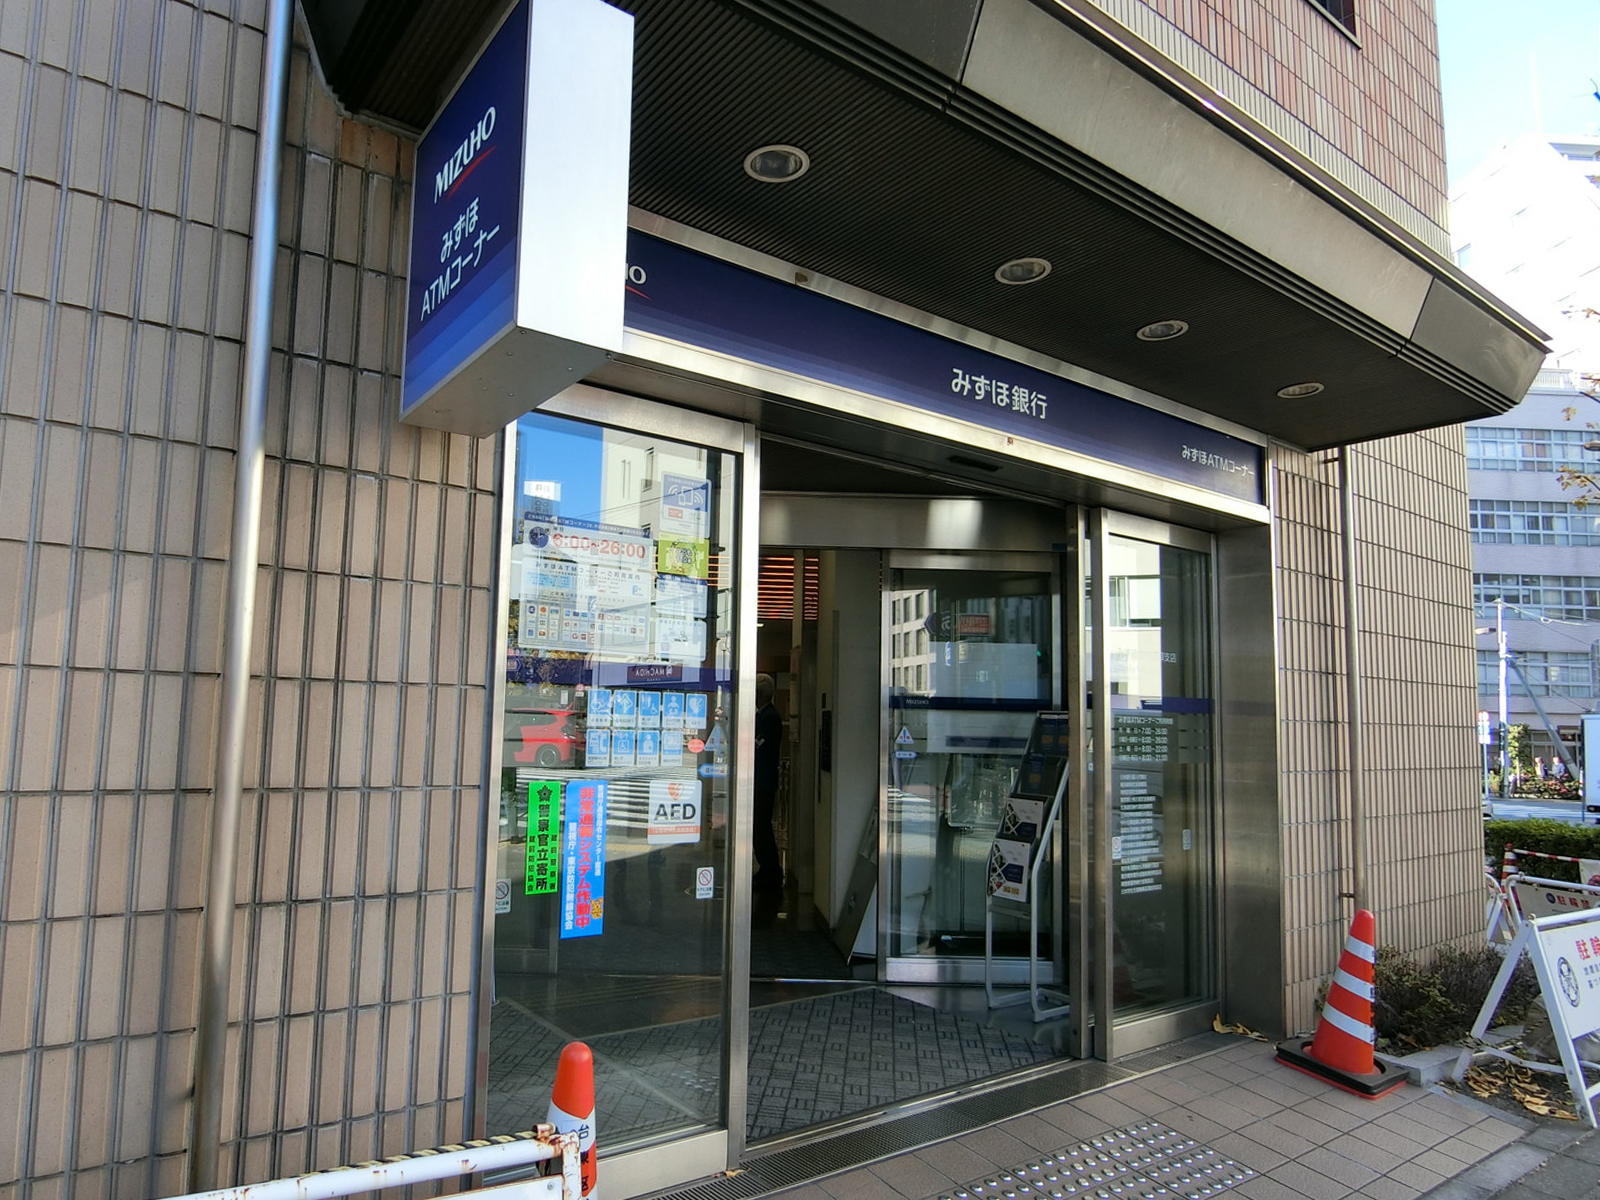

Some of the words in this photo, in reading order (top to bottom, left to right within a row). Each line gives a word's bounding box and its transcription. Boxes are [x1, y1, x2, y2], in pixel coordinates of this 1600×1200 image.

[433, 106, 497, 204] MIZUHO
[439, 197, 480, 263] みずほ
[420, 223, 501, 322] ATMコーナー
[951, 367, 1048, 420] みずほ銀行
[1181, 444, 1256, 477] みずほATMコーナー
[535, 803, 551, 891] 警察官立寄所
[653, 803, 697, 821] AED
[575, 787, 596, 929] 非常通報システム作動中
